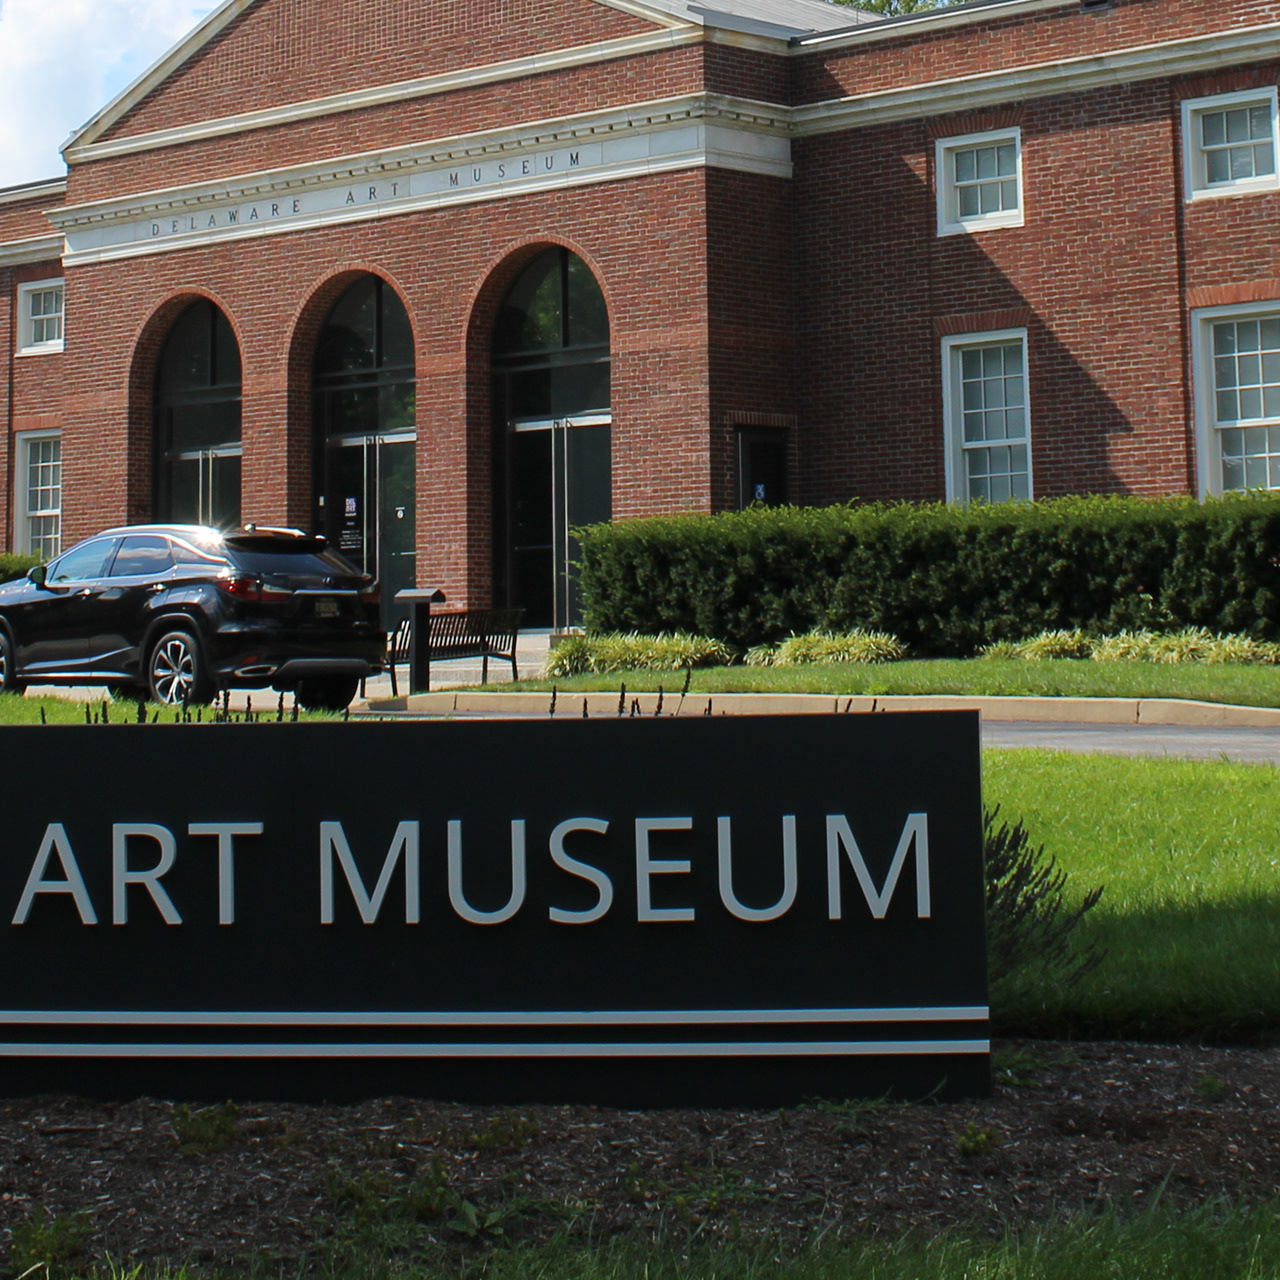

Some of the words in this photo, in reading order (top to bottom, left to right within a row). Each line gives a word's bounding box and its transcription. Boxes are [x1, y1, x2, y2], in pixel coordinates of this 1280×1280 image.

[151, 199, 301, 237] DELAWARE
[345, 182, 399, 205] ART
[449, 151, 580, 187] MUSEUM
[11, 821, 264, 926] ART
[318, 812, 932, 926] MUSEUM
